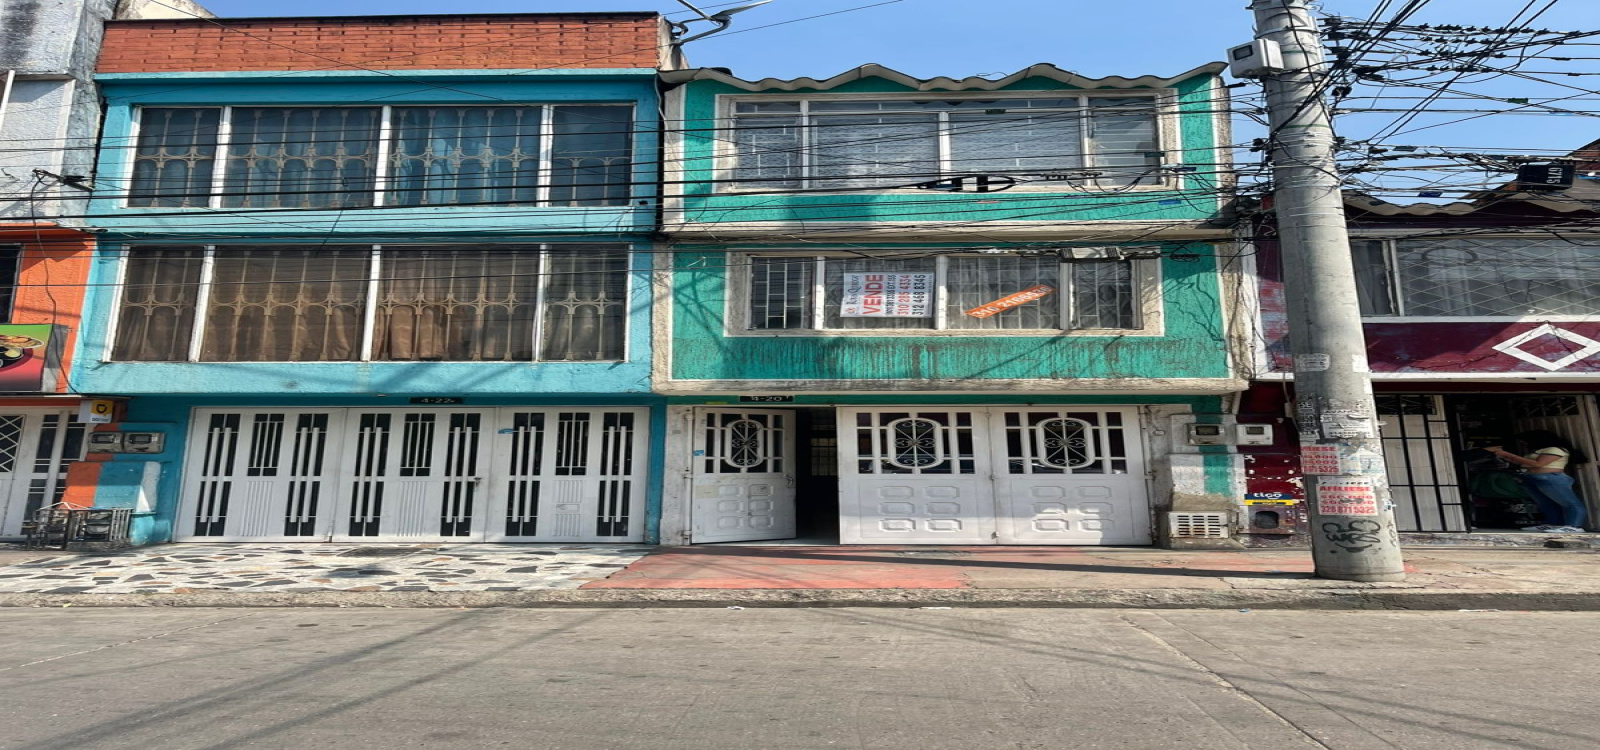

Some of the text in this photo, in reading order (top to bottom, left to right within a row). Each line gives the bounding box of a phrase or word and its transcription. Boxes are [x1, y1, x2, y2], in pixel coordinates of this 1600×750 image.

[1546, 167, 1563, 184] 6715
[862, 275, 883, 315] VENDE
[898, 305, 910, 315] 310
[912, 305, 925, 315] 312
